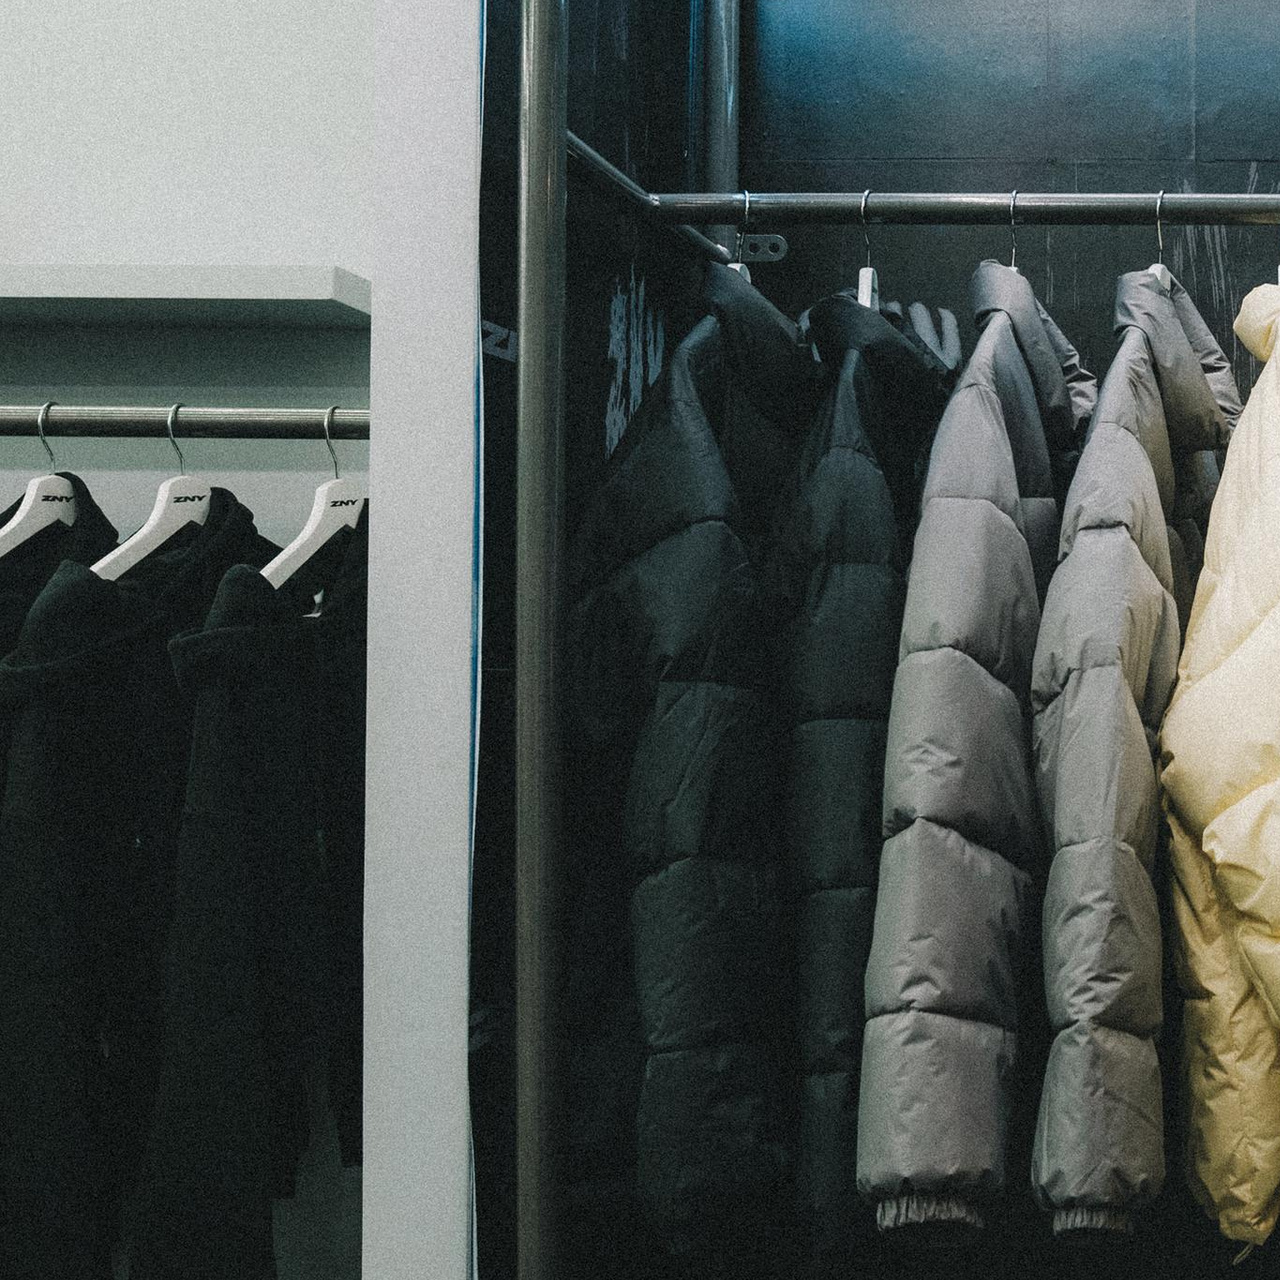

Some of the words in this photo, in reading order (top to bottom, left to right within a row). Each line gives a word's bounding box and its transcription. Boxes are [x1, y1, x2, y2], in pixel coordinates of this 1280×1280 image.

[41, 494, 74, 503] ZNY
[173, 494, 206, 504] ZNY
[330, 499, 358, 508] ZNY
